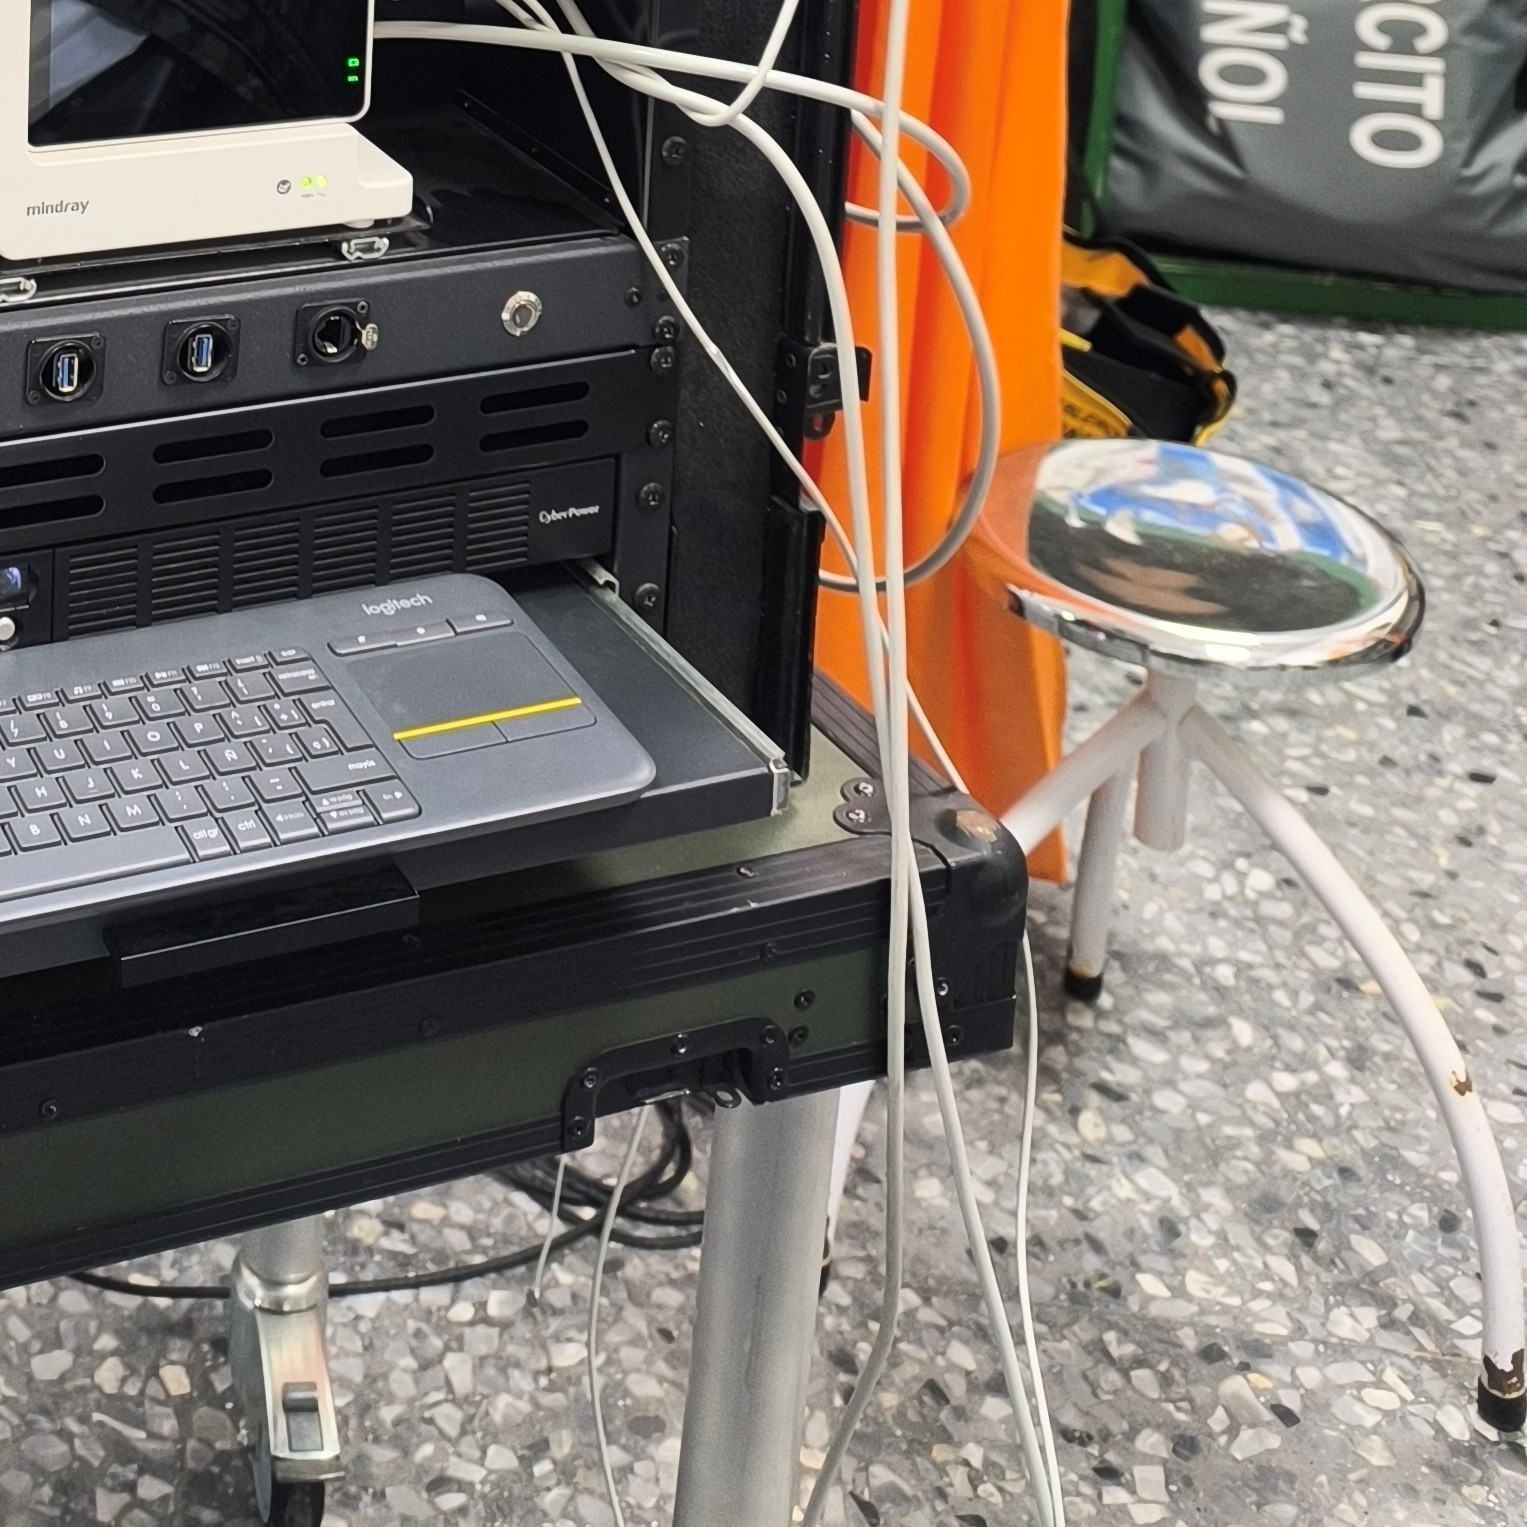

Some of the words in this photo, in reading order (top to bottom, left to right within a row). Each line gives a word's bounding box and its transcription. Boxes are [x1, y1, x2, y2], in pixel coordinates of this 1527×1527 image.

[26, 199, 90, 218] mindray
[362, 592, 434, 616] logitech
[193, 722, 204, 733] P
[53, 748, 66, 760] U
[6, 757, 17, 768] Y
[179, 759, 190, 770] L
[131, 768, 143, 780] K
[35, 786, 49, 798] H
[126, 804, 142, 817] M
[77, 813, 92, 827] N
[237, 819, 257, 832] ctrl
[29, 824, 41, 836] B
